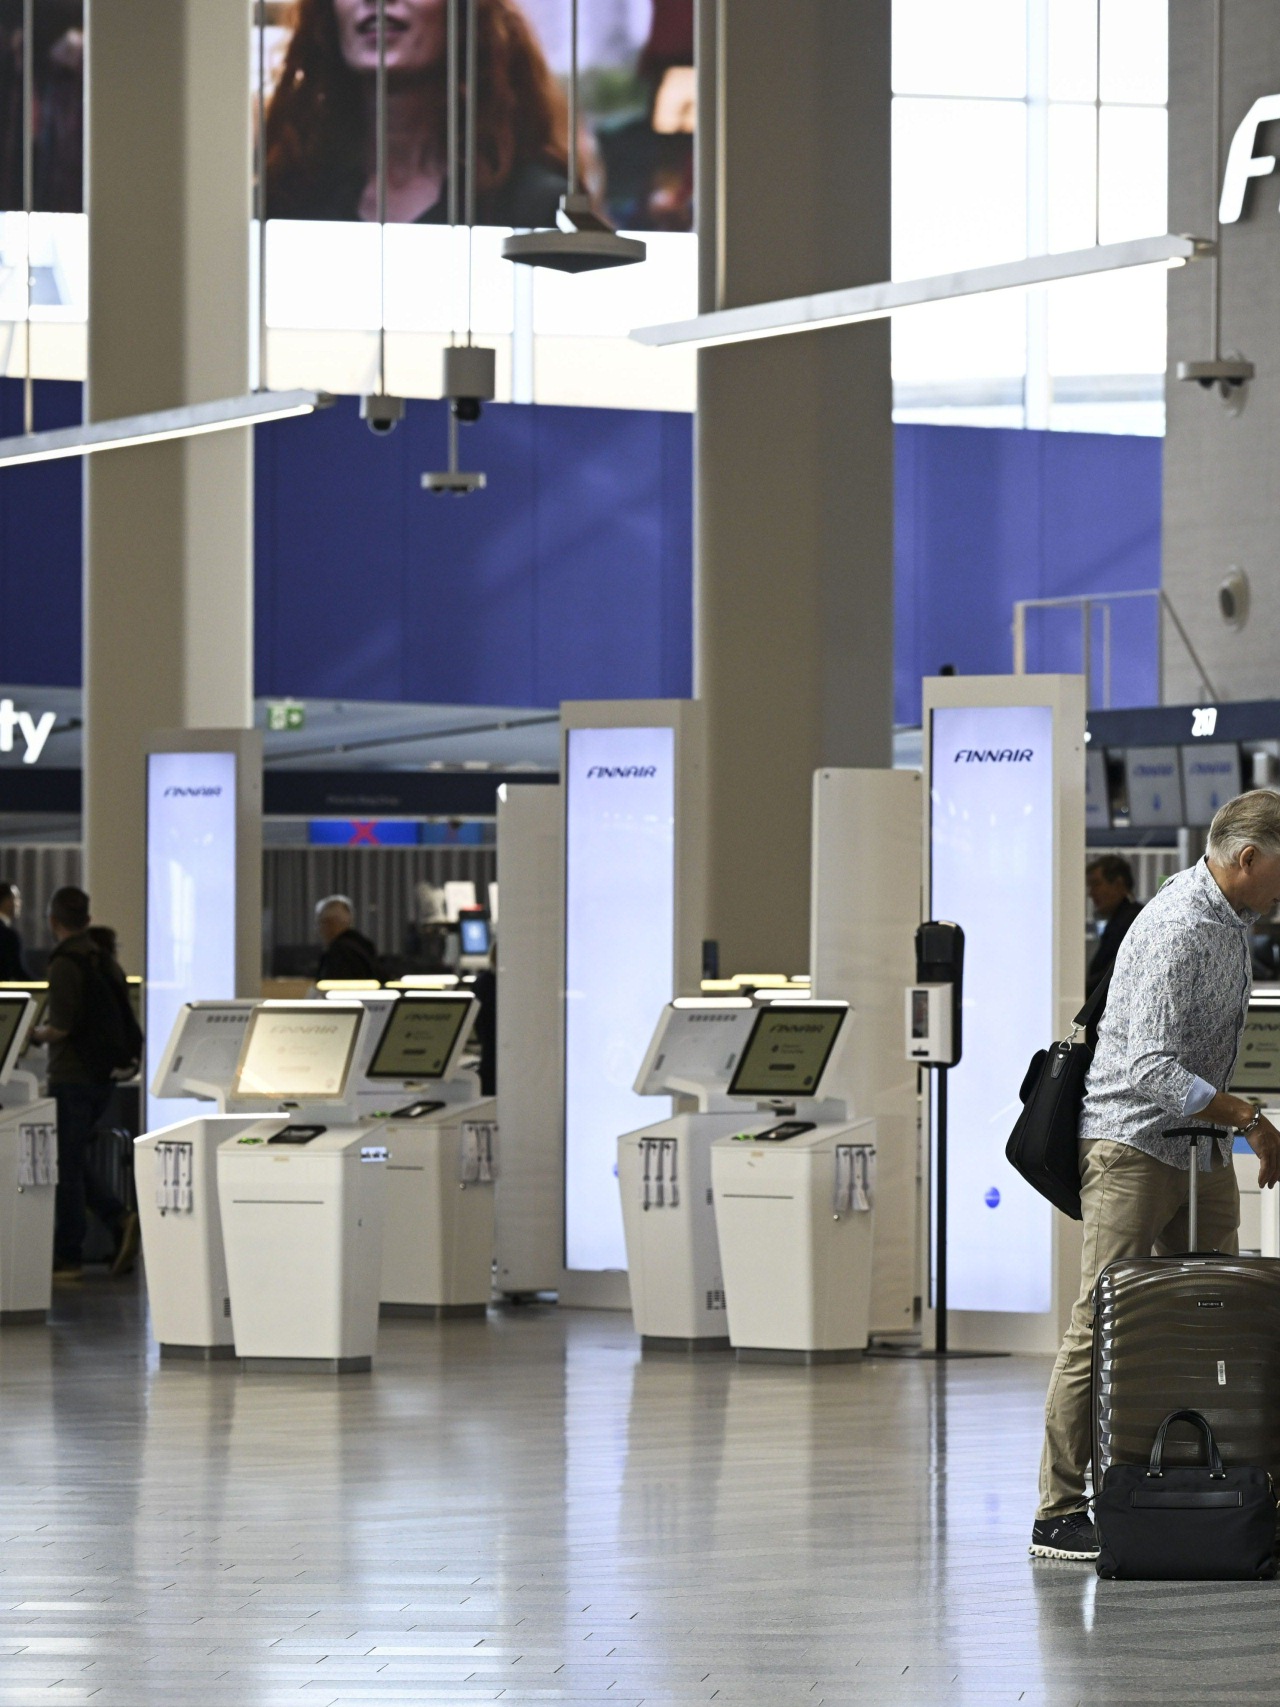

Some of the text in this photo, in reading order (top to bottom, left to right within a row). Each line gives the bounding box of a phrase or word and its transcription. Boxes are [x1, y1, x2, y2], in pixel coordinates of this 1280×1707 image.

[1191, 708, 1217, 737] 217
[954, 748, 1033, 763] FINNAIR
[586, 766, 657, 779] FINNAIR
